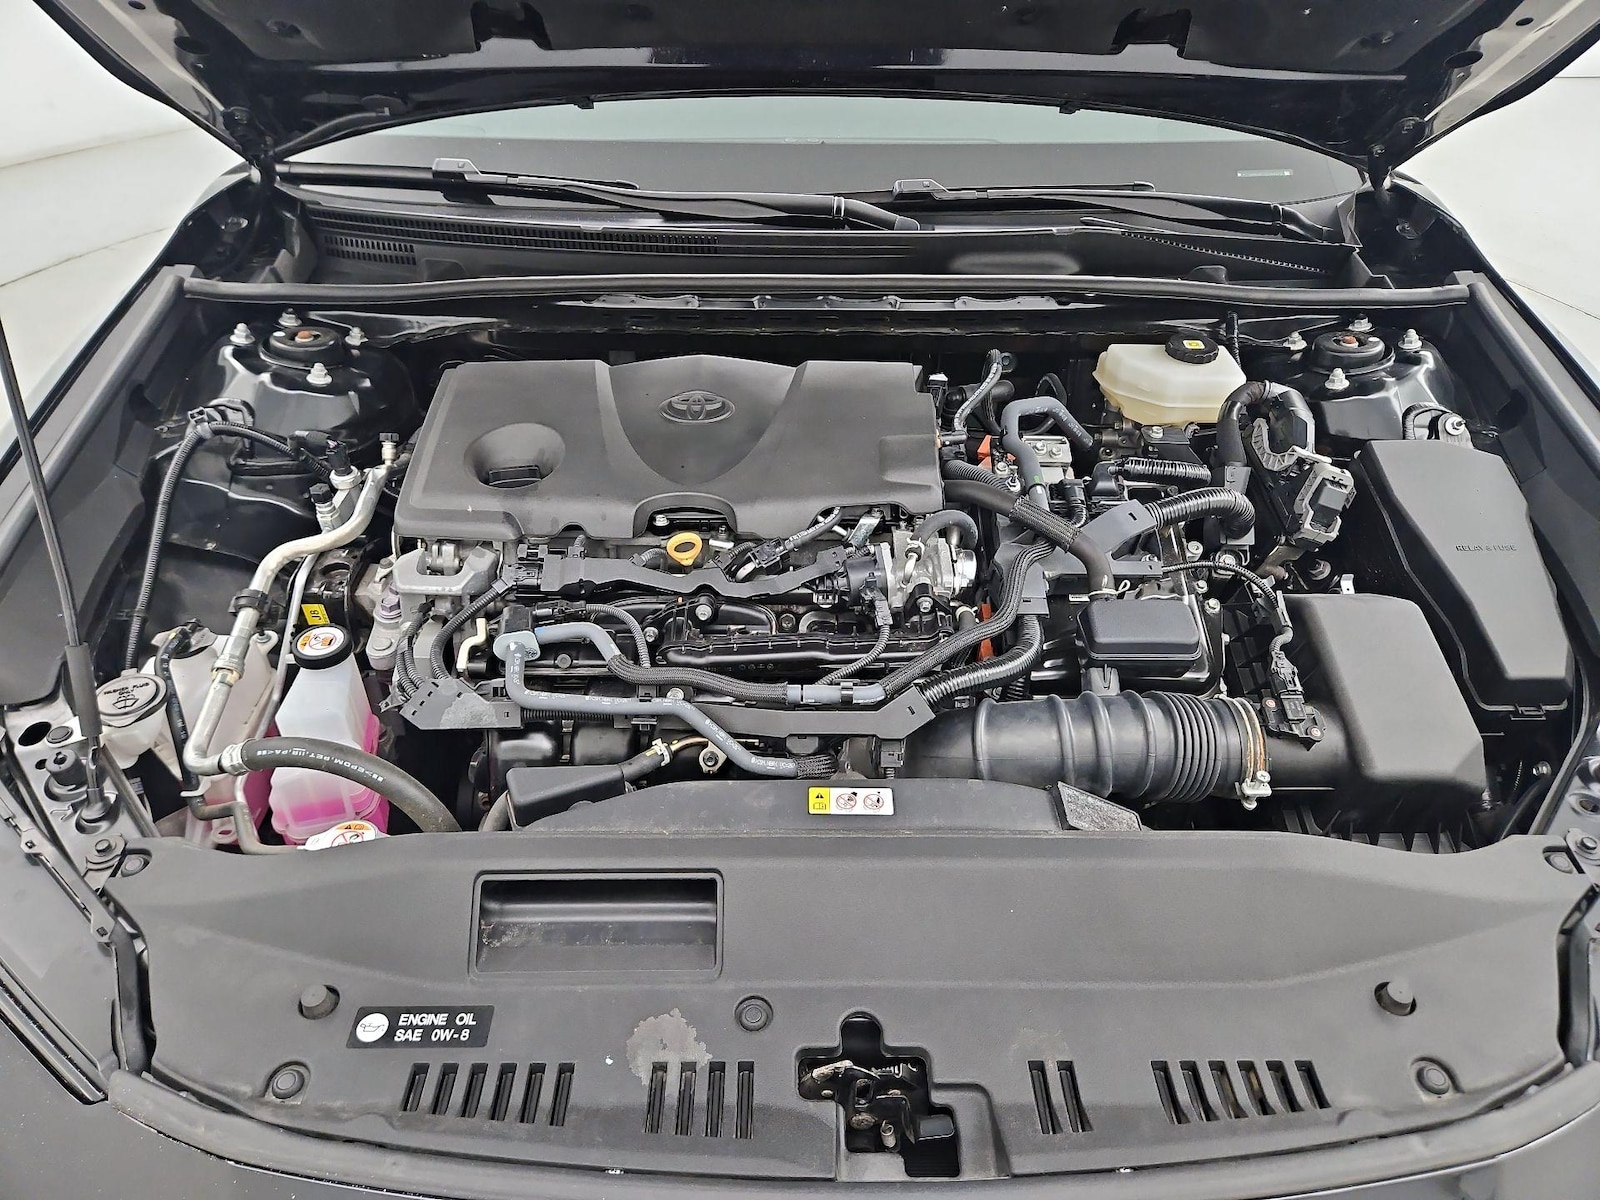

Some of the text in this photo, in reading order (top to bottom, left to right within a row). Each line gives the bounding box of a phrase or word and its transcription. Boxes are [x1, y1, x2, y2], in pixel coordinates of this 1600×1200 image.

[398, 1013, 477, 1026] ENGINE OIL
[394, 1029, 470, 1041] SAE 0W-8
